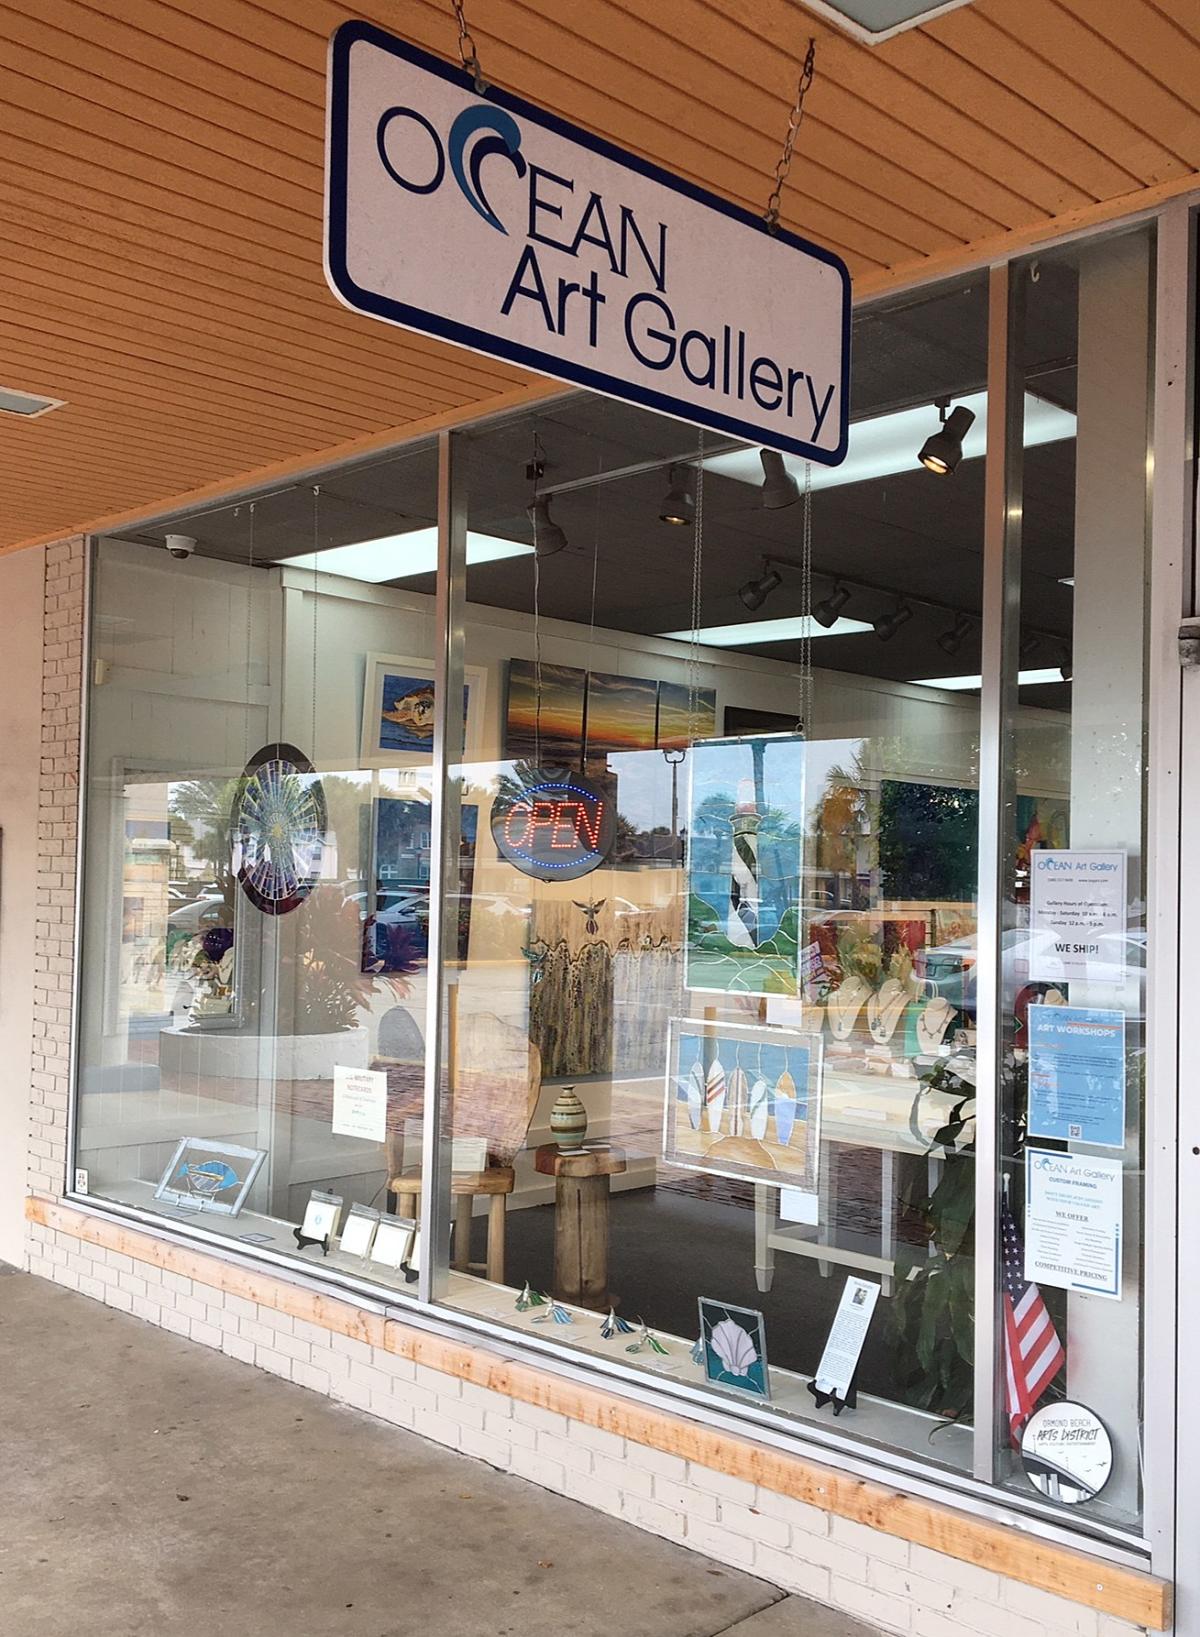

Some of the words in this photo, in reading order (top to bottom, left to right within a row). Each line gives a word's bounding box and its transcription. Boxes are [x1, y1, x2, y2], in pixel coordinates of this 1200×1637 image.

[377, 104, 667, 293] OCEAN
[500, 245, 606, 347] Art
[624, 292, 835, 442] Gallery
[504, 801, 604, 848] OPEN
[1037, 858, 1072, 871] OCEAN
[1076, 862, 1087, 870] Art
[1089, 862, 1118, 872] Gallery
[1055, 944, 1071, 953] WE
[1072, 944, 1099, 954] SHIP!
[1037, 1023, 1054, 1032] ART
[1057, 1025, 1116, 1037] WORKSHOPS
[1034, 1158, 1069, 1174] OCEAN
[1069, 1166, 1082, 1176] Art
[1083, 1168, 1115, 1182] Gallery
[1048, 1176, 1071, 1185] CUSTOM
[1072, 1180, 1097, 1189] FRAMING
[1055, 1210, 1067, 1219] WE
[1067, 1213, 1089, 1222] OFFER
[1034, 1260, 1079, 1276] COMPETITIVE
[1079, 1270, 1108, 1281] PRICING
[1042, 1419, 1068, 1427] ORMOND
[1070, 1418, 1091, 1427] BEACH
[1037, 1429, 1059, 1440] ARTS
[1061, 1427, 1101, 1440] DISTRICT
